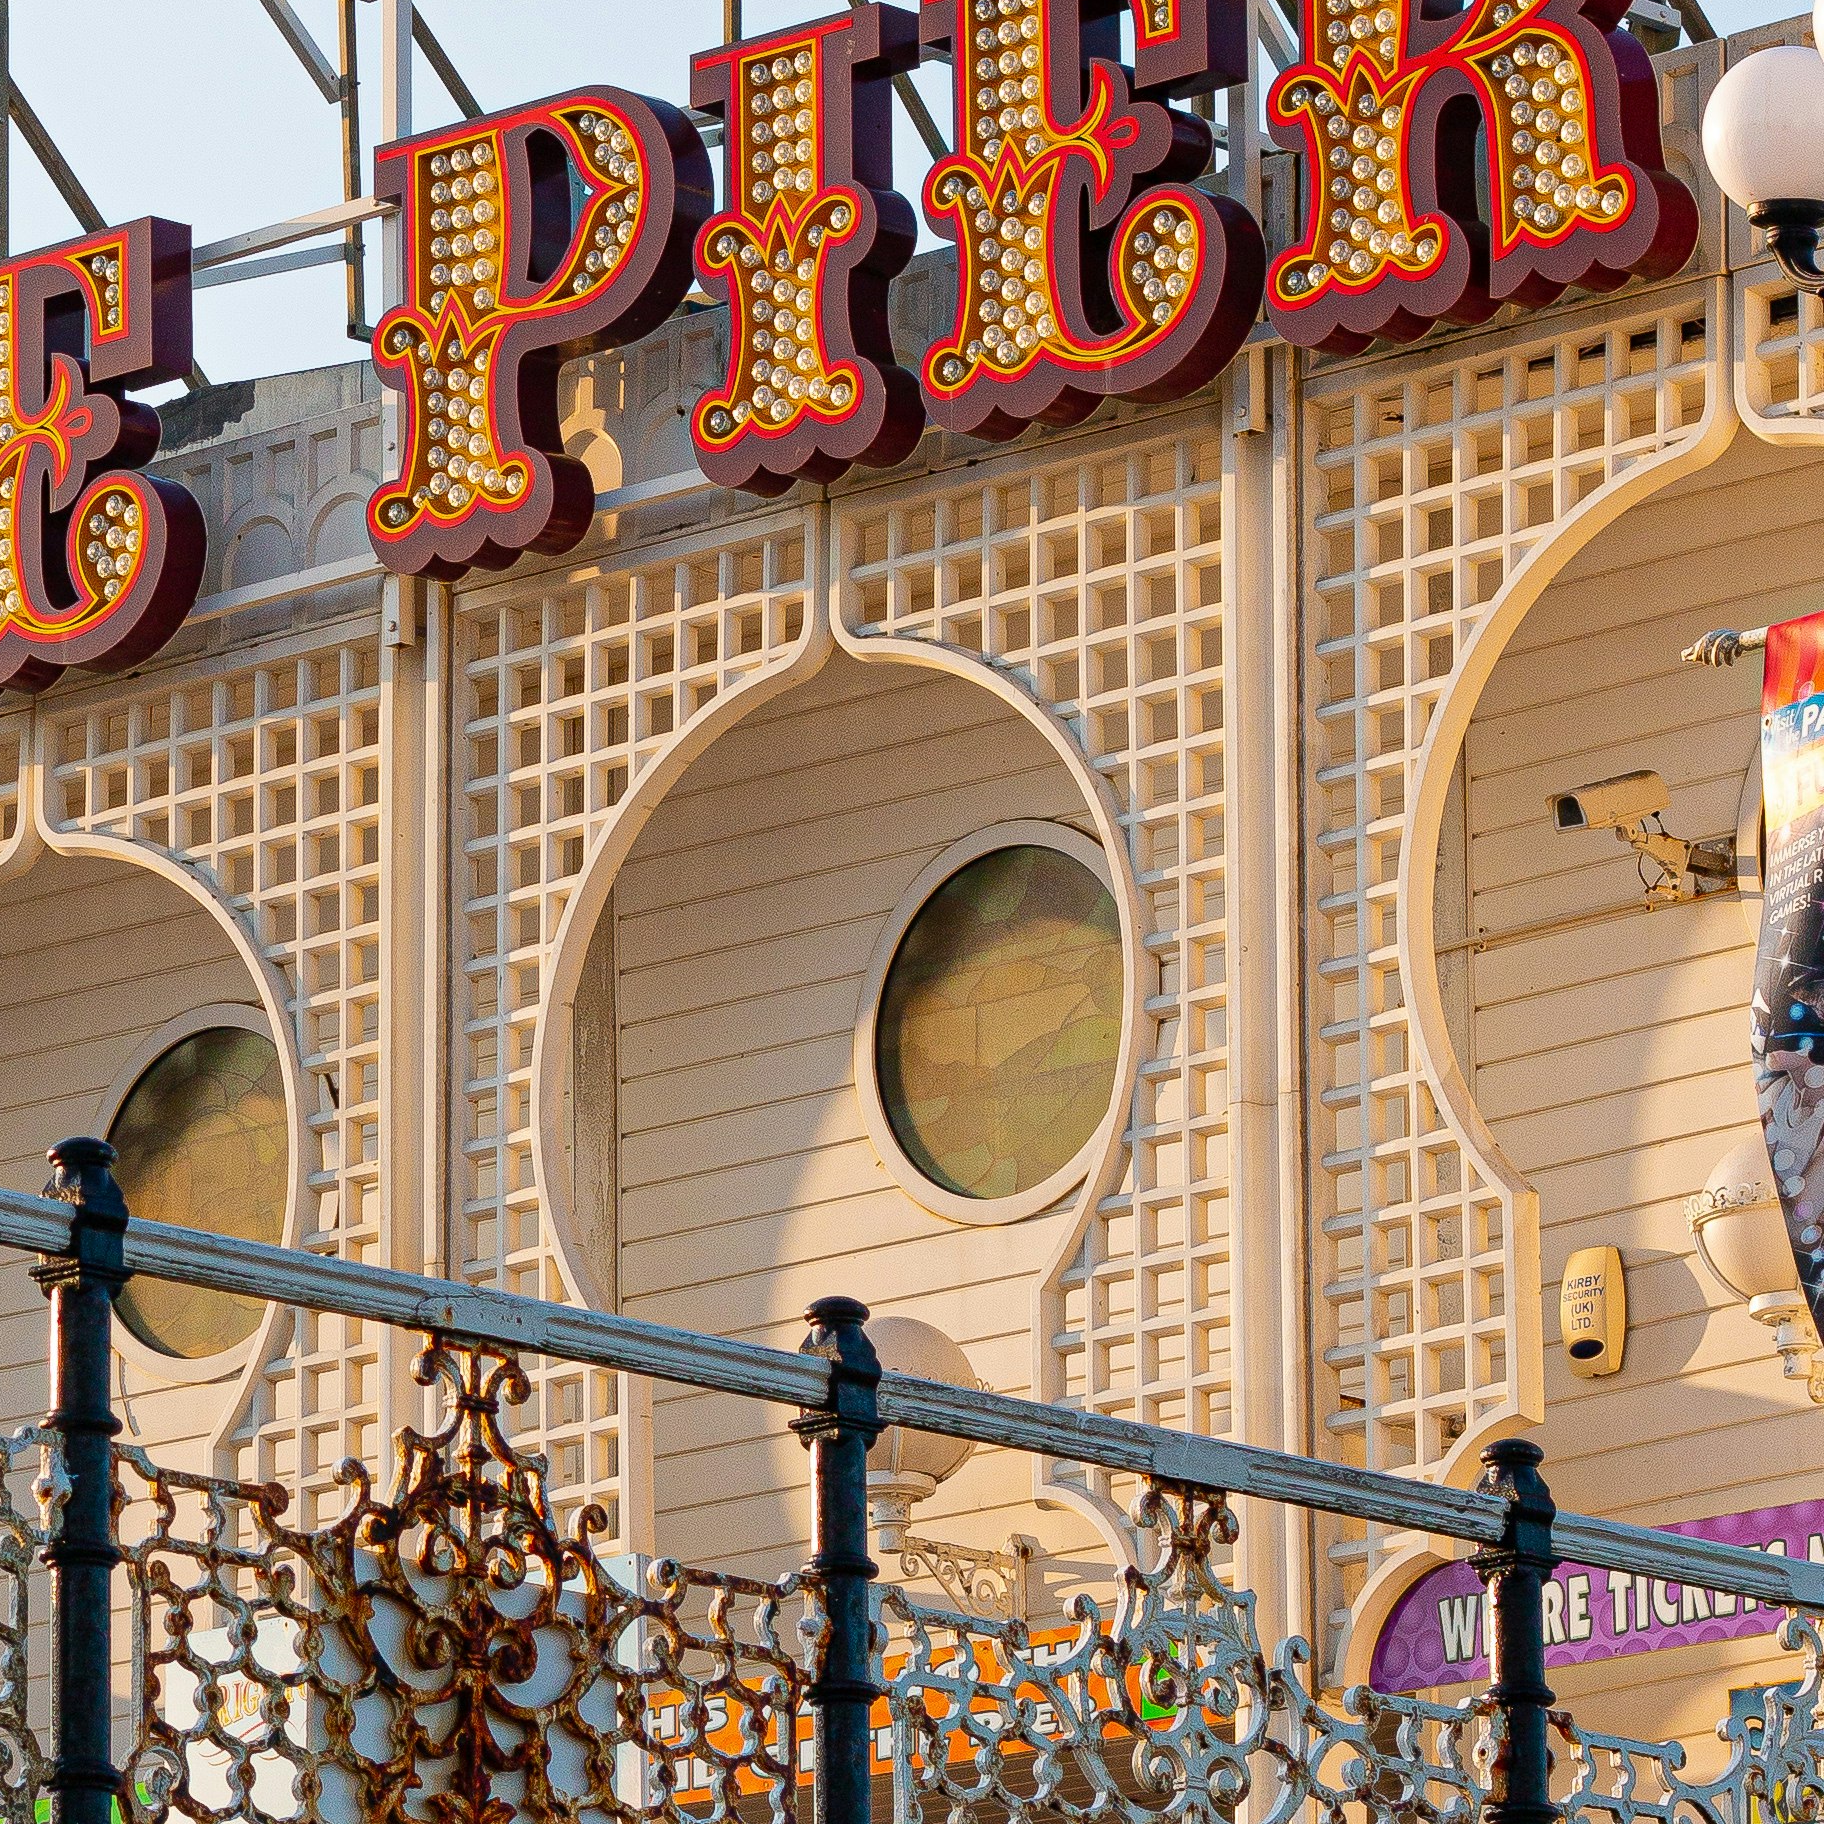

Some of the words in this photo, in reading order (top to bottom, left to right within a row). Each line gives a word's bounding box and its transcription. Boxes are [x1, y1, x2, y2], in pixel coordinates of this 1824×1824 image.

[1769, 830, 1817, 868] IMMERSE
[1769, 869, 1783, 888] IN
[1783, 857, 1803, 880] THE
[1769, 872, 1811, 907] VIRTUAL
[1769, 892, 1811, 925] GAMES!
[1562, 1286, 1605, 1303] SECURITY
[1567, 1274, 1602, 1291] KIRBY
[1571, 1300, 1594, 1318] (UK)
[1571, 1316, 1595, 1331] LTD.
[1438, 1572, 1594, 1664] WRE
